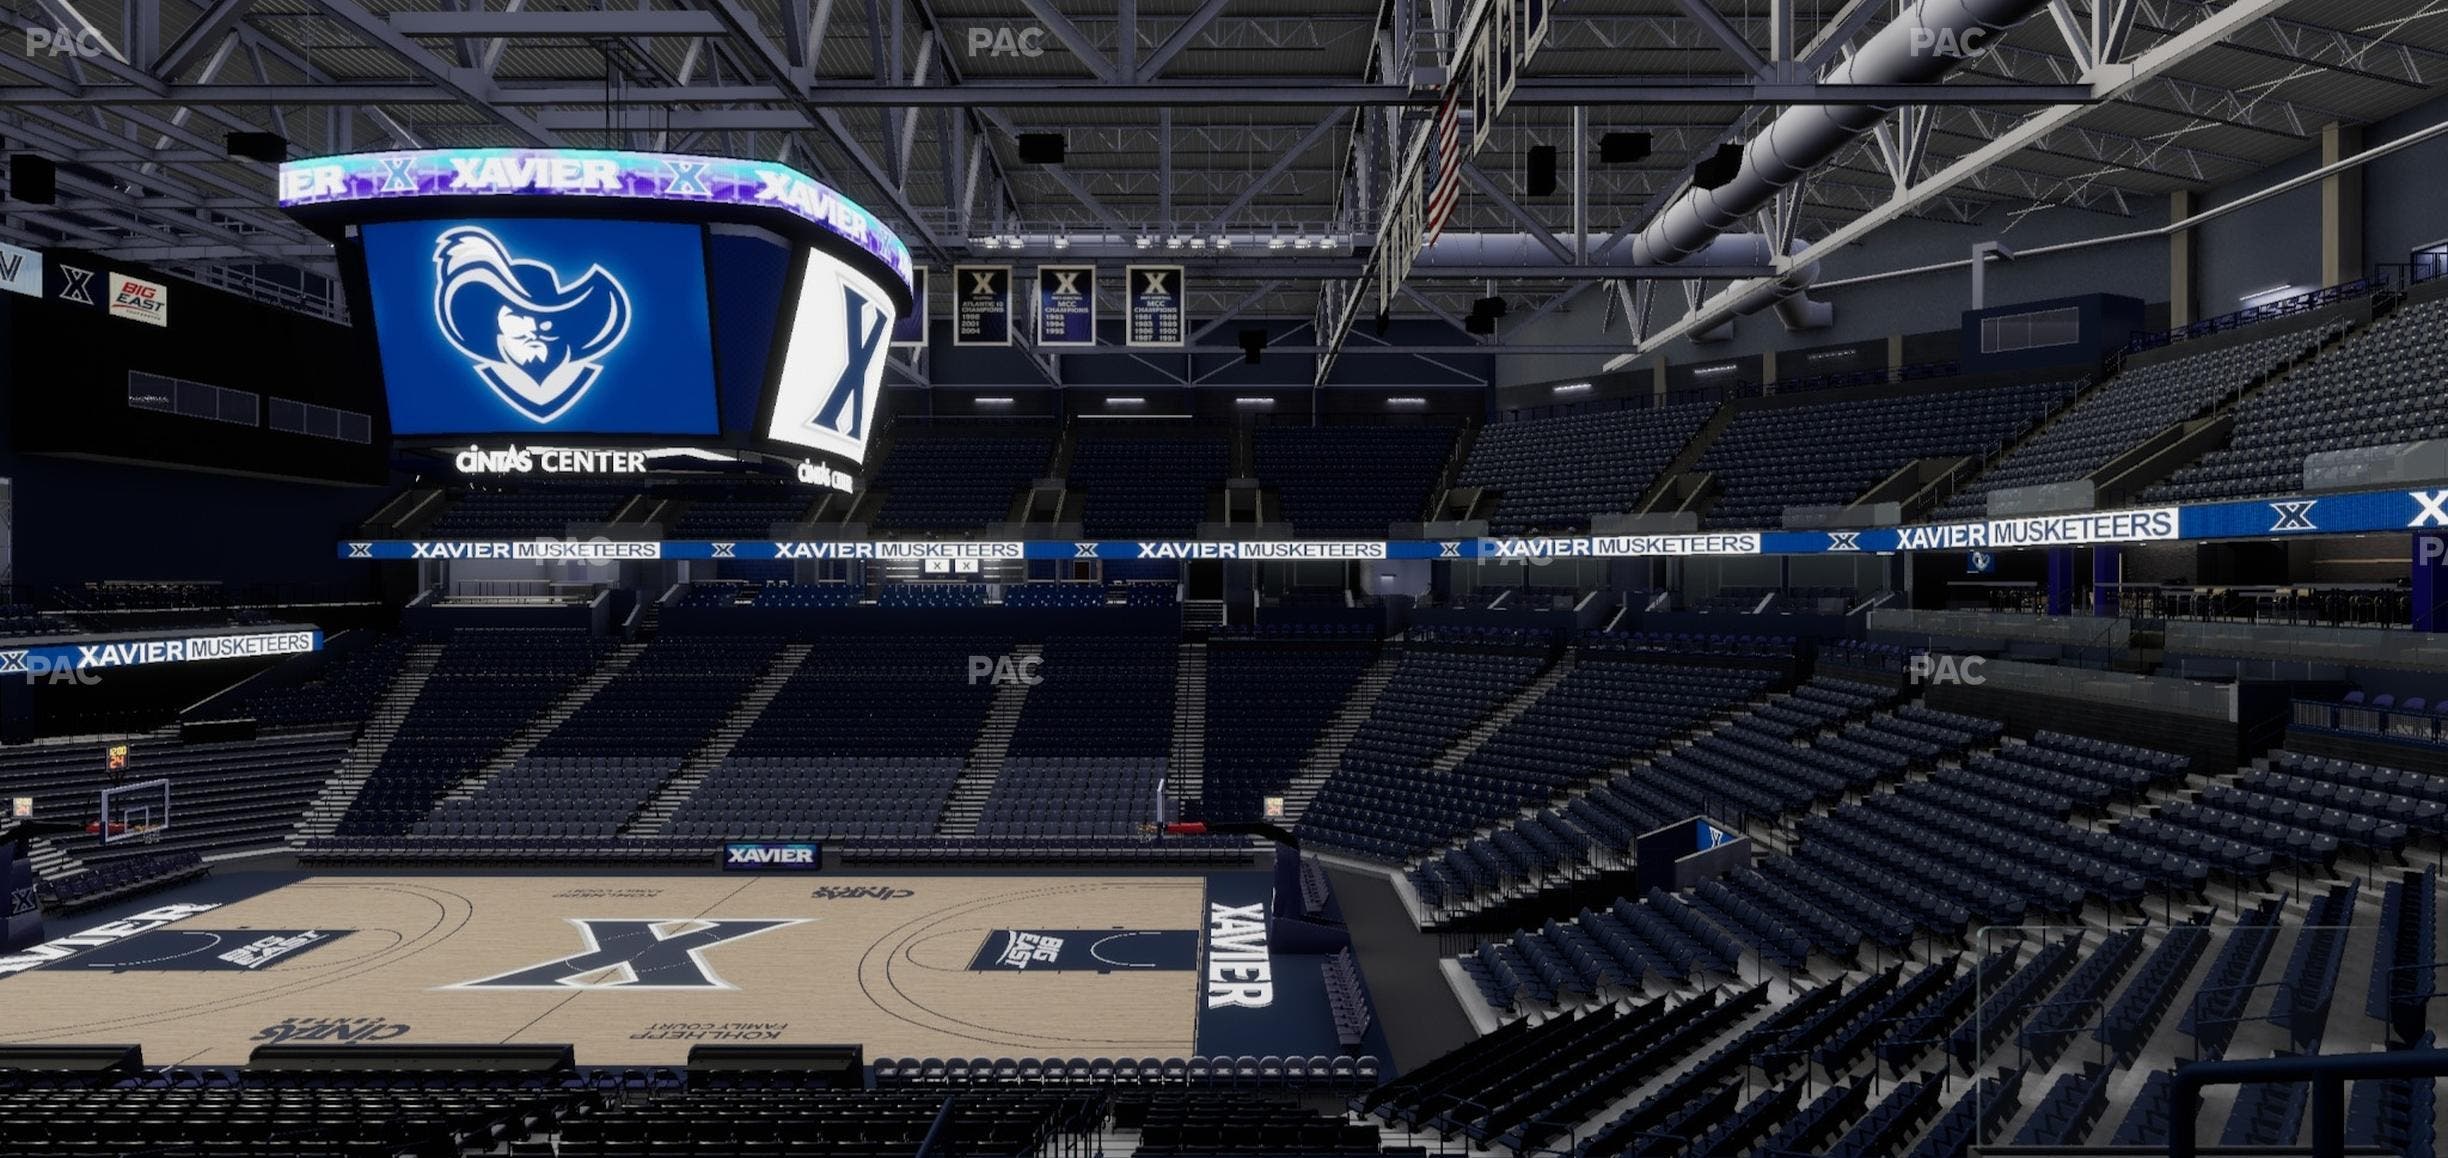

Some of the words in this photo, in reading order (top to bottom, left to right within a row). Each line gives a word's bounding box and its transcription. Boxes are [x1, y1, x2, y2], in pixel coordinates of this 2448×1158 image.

[380, 158, 419, 191] X
[450, 157, 622, 190] XAVIER
[662, 160, 713, 196] X
[755, 170, 869, 243] XAVIER
[60, 264, 95, 306] X
[121, 281, 157, 299] BIG
[971, 272, 996, 295] X
[1053, 272, 1081, 295] X
[1143, 272, 1170, 295] X
[115, 293, 165, 312] EAST
[808, 278, 889, 443] X
[541, 451, 647, 473] CENTER
[2269, 500, 2318, 532] X
[348, 543, 373, 558] X
[412, 542, 511, 559] XAVIER
[518, 543, 657, 557] MUSKETEERS
[711, 543, 736, 558] X
[774, 542, 873, 559] XAVIER
[882, 543, 1020, 557] MUSKETEERS
[1074, 543, 1099, 558] X
[1137, 542, 1237, 559] XAVIER
[1244, 543, 1382, 557] MUSKETEERS
[1440, 542, 1461, 557] X
[1495, 538, 1590, 557] XAVIER
[1600, 535, 1755, 554] MUSKETEERS
[1827, 532, 1861, 551] X
[1896, 524, 1989, 551] XAVIER
[1994, 512, 2173, 544] MUSKETEERS
[0, 649, 29, 672] X
[75, 640, 185, 669] XAVIER
[191, 633, 310, 658] MUSKETEERS
[727, 848, 814, 863] XAVIER
[217, 935, 286, 962] BIG
[428, 918, 820, 990] X
[1004, 932, 1041, 969] EAST
[1033, 936, 1064, 963] BIG
[1208, 902, 1273, 1009] XAVIER
[629, 1031, 783, 1040] KOHLHEPP
[717, 1023, 789, 1031] FAMILY
